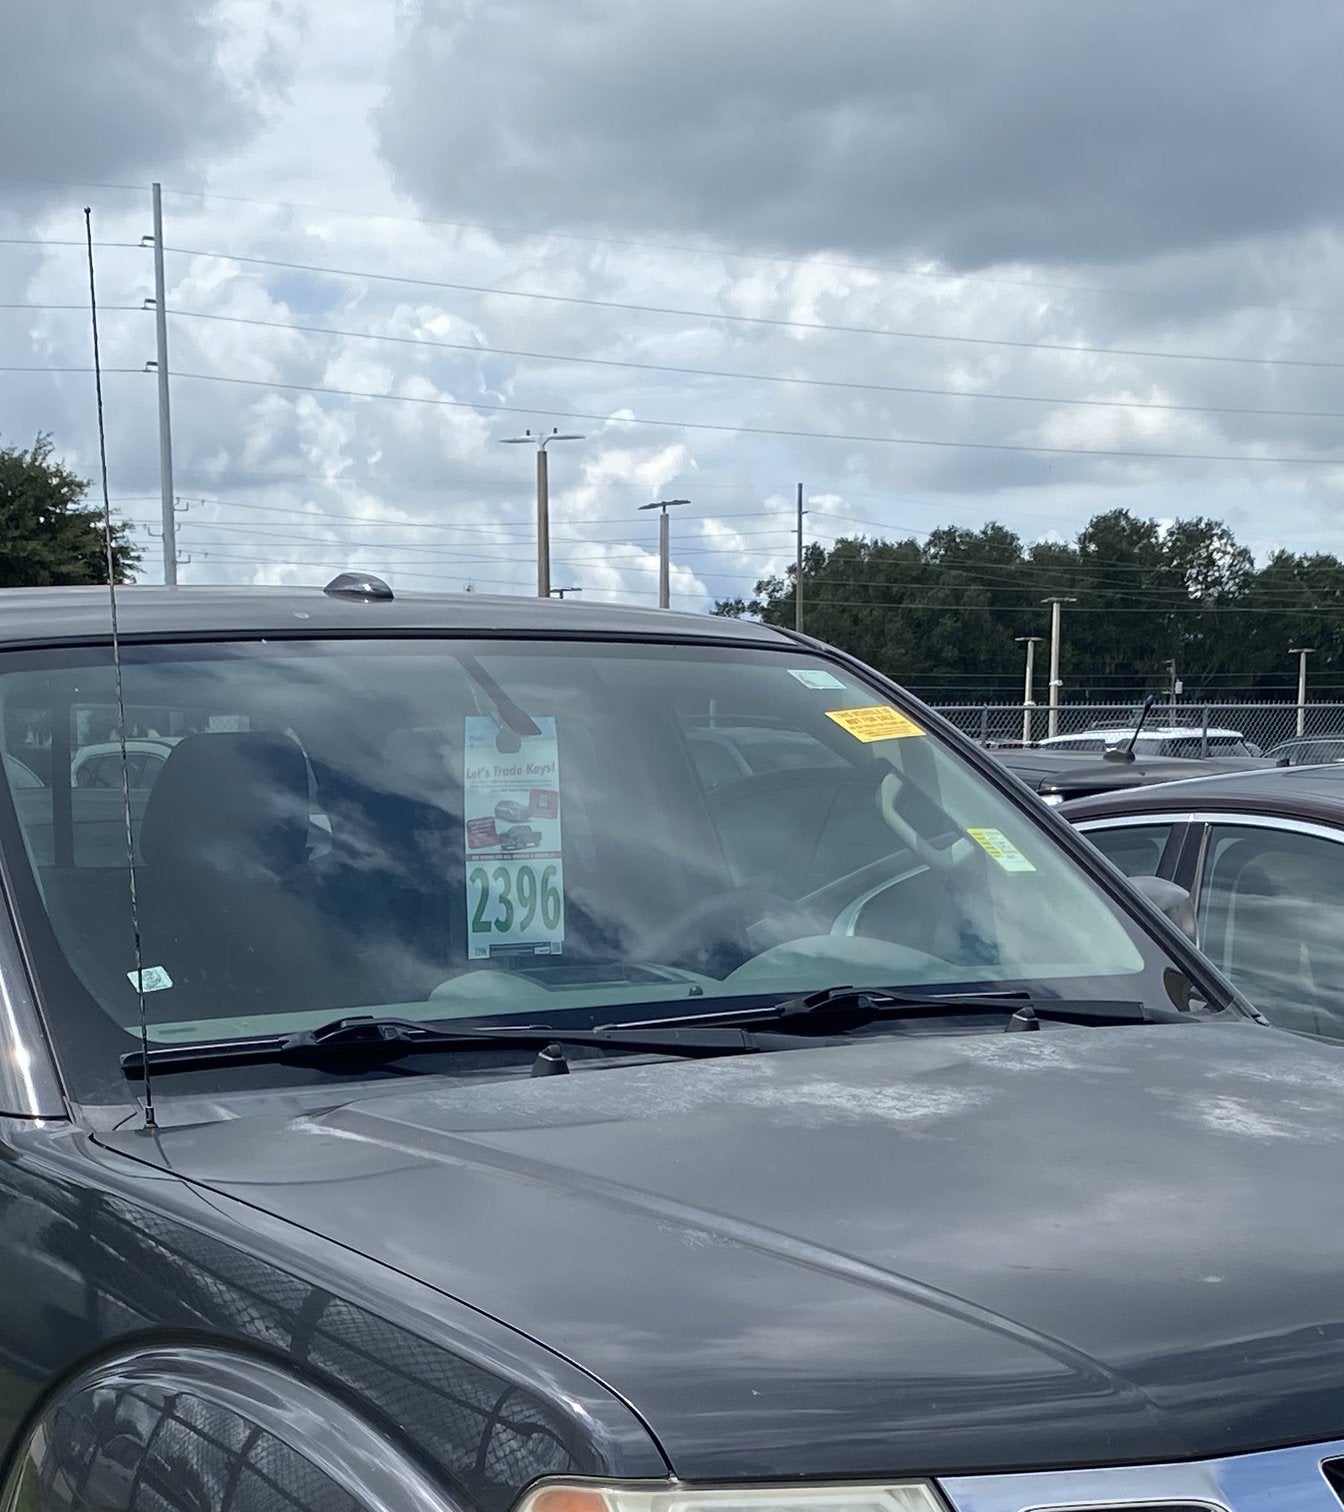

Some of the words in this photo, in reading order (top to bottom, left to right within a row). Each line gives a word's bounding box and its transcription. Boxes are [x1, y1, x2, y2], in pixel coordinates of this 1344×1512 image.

[493, 764, 523, 777] Trade
[526, 761, 555, 776] Keys!
[469, 864, 561, 934] 2396
